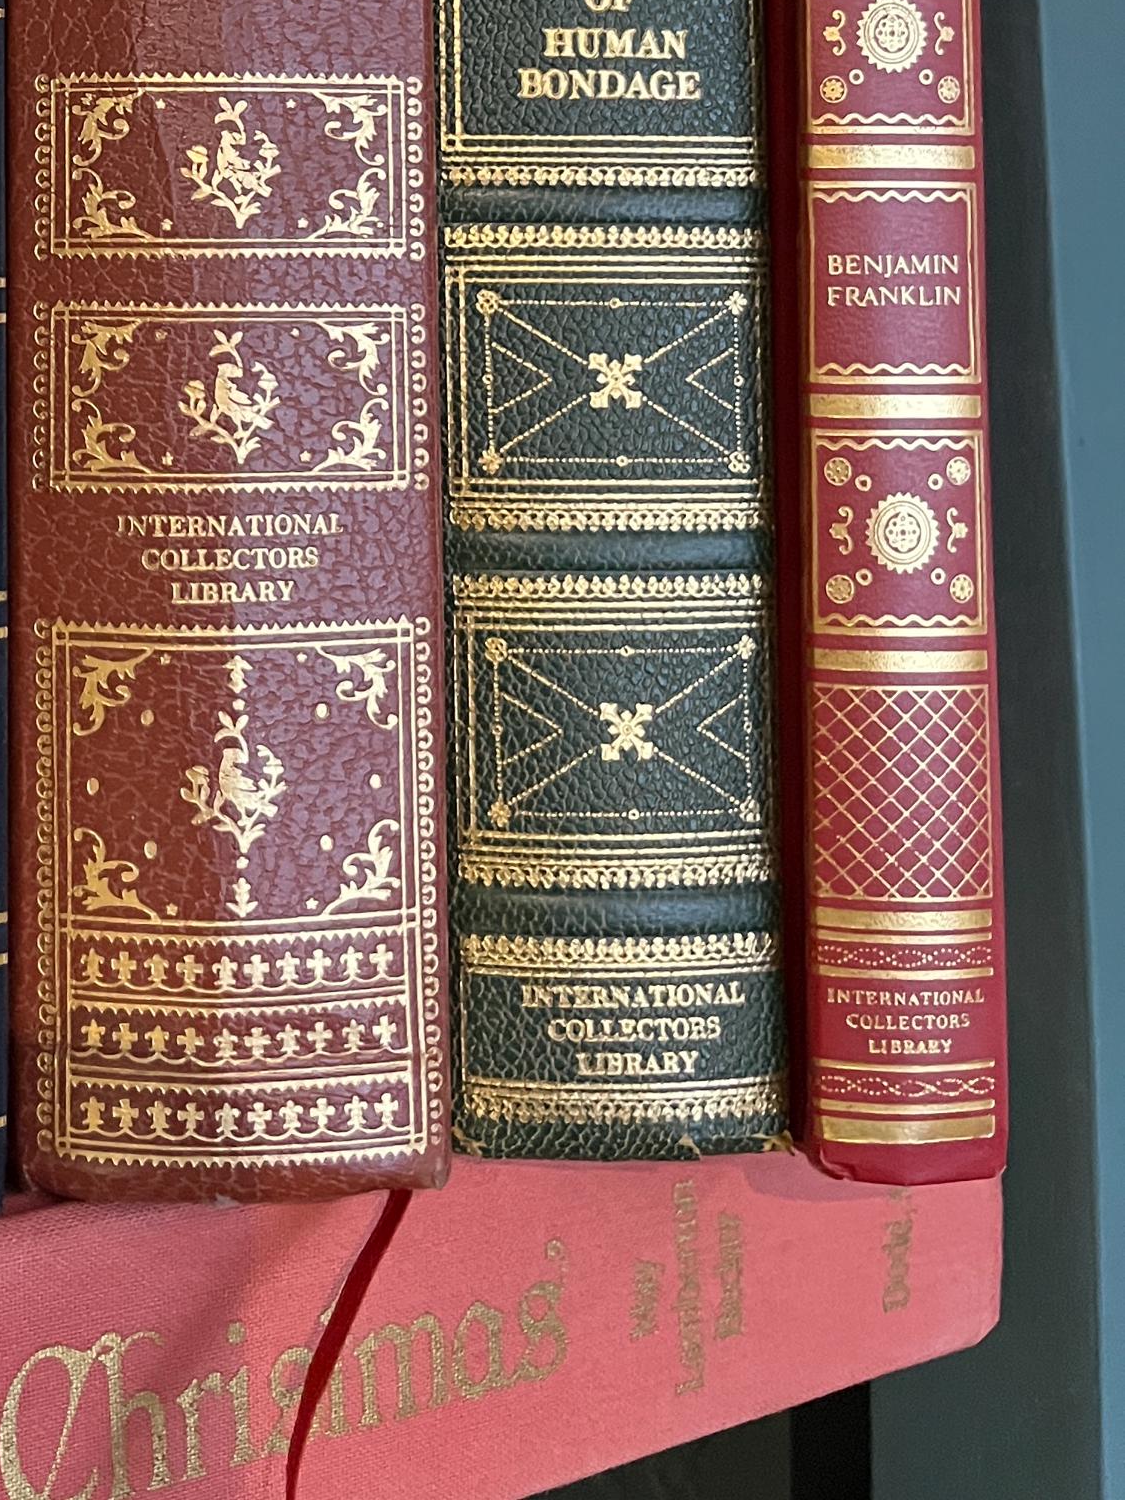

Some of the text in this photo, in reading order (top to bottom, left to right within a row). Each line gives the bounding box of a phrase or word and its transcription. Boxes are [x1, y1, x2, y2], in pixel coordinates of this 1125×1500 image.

[542, 27, 689, 59] HUMAN
[517, 68, 701, 101] BONDAGE
[827, 254, 959, 278] BENJAMIN
[827, 285, 961, 307] FRANKLIN
[115, 513, 344, 538] INTERNATIONAL
[141, 546, 320, 572] COLLECTORS
[171, 580, 295, 605] LIBRARY
[521, 981, 746, 1008] INTERNATIONAL
[827, 987, 985, 1006] INTERNATIONAL
[547, 1016, 722, 1043] COLLECTORS
[845, 1013, 971, 1031] COLLECTORS
[868, 1038, 952, 1055] LIBRARY
[577, 1050, 699, 1076] LIBRARY
